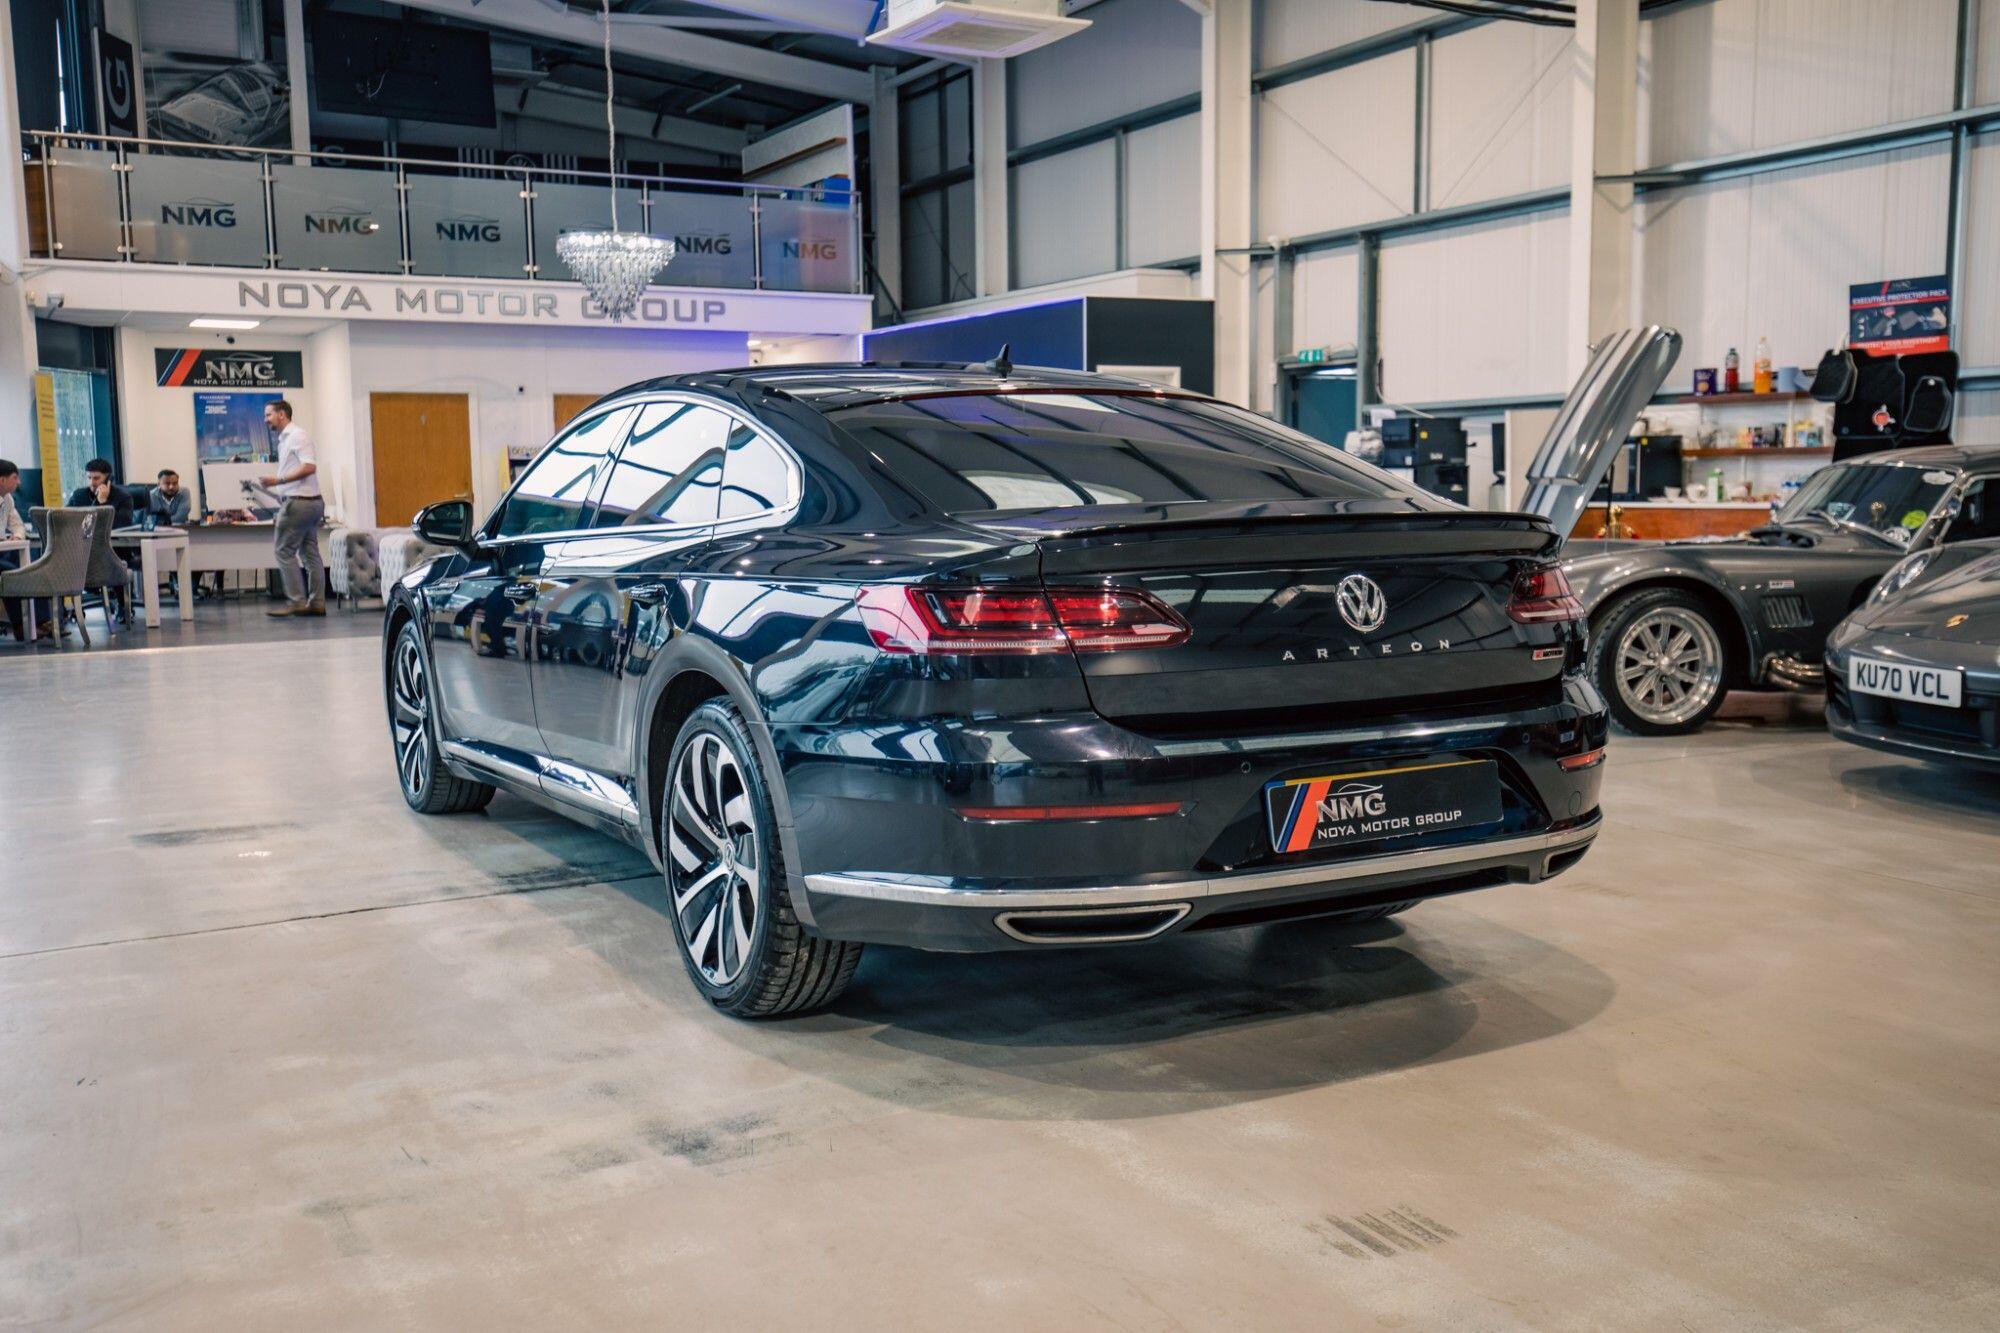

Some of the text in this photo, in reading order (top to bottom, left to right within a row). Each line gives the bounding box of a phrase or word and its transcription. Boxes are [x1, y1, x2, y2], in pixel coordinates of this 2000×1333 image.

[161, 204, 237, 228] NMG
[305, 213, 375, 235] NMG
[436, 222, 501, 242] NMG
[674, 236, 732, 255] NMG
[783, 242, 837, 260] NMG
[238, 281, 372, 312] NOYA
[395, 287, 559, 318] MOTOR
[205, 360, 276, 380] NMG
[256, 379, 288, 387] GROUP
[1282, 638, 1450, 661] ARTEON
[1856, 662, 1950, 700] KU70 VCL
[1315, 791, 1387, 823] NMG
[1317, 809, 1462, 840] NOYA MOTOR GROUP
